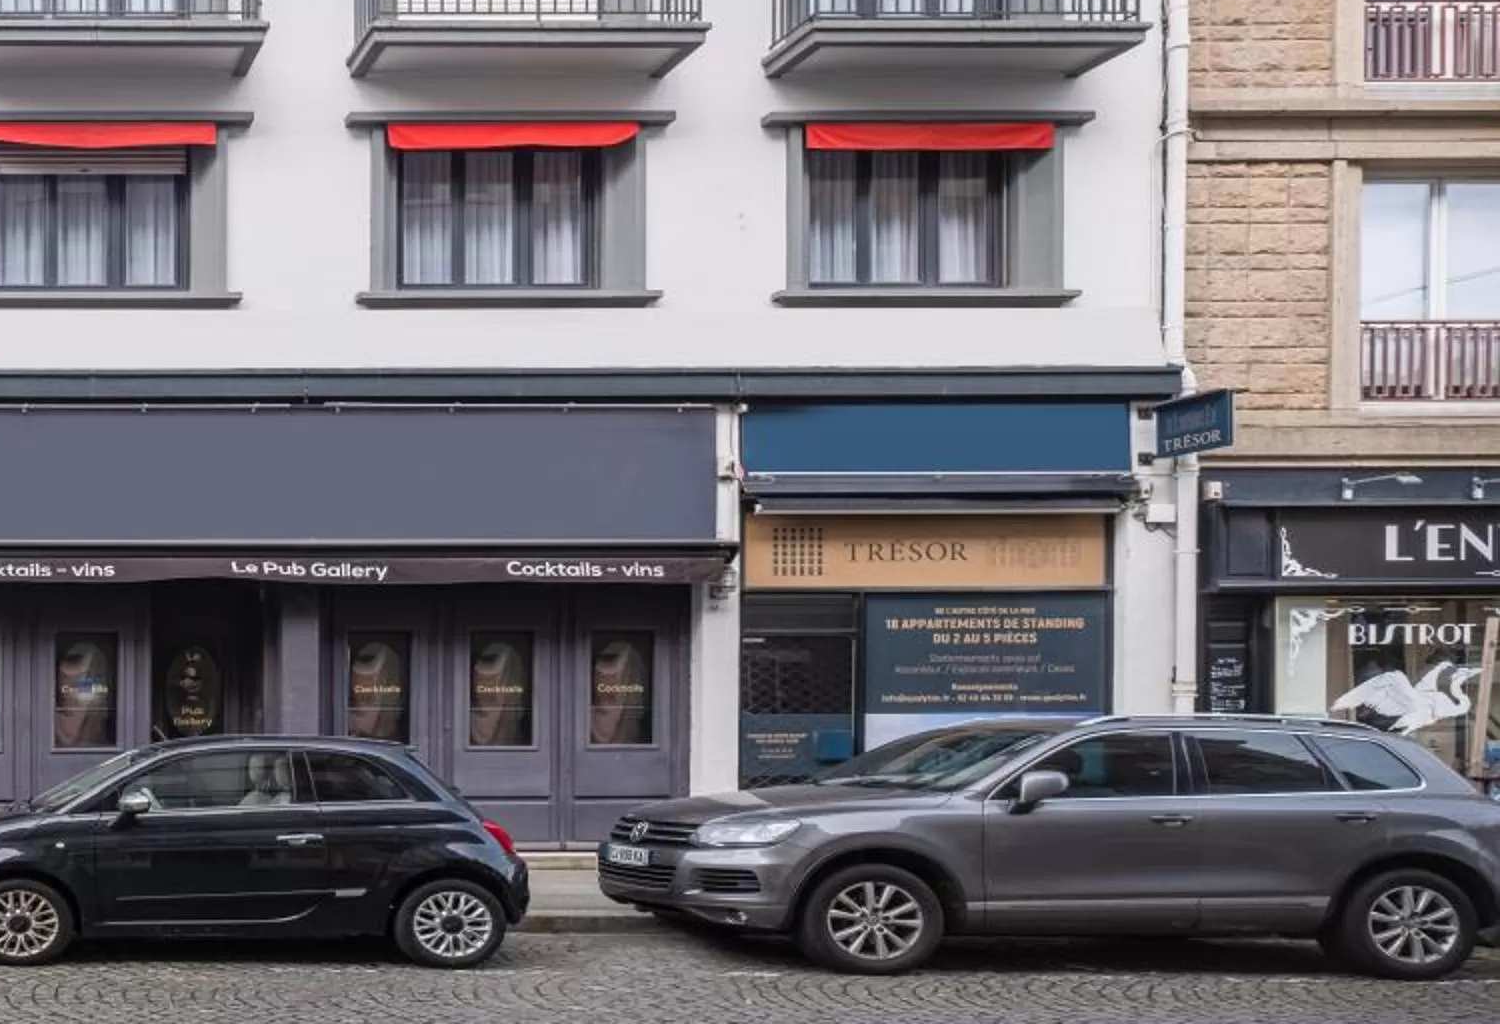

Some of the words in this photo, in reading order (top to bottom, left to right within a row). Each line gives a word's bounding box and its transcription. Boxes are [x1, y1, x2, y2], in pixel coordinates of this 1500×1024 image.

[1385, 520, 1500, 562] L'EN
[844, 538, 968, 562] TRÉSOR
[71, 562, 116, 577] vins
[231, 561, 258, 573] Le
[263, 561, 306, 576] Pub
[310, 562, 388, 581] Gallery
[506, 561, 602, 577] Cocktails
[621, 562, 664, 577] vins
[902, 618, 1001, 629] APPARTEMENTS
[1003, 618, 1019, 629] DE
[1021, 618, 1085, 630] STANDING
[933, 633, 950, 644] DU
[952, 633, 960, 644] 2
[963, 633, 980, 644] AU
[1348, 623, 1476, 645] BISTROT
[597, 683, 644, 693] Cocktails
